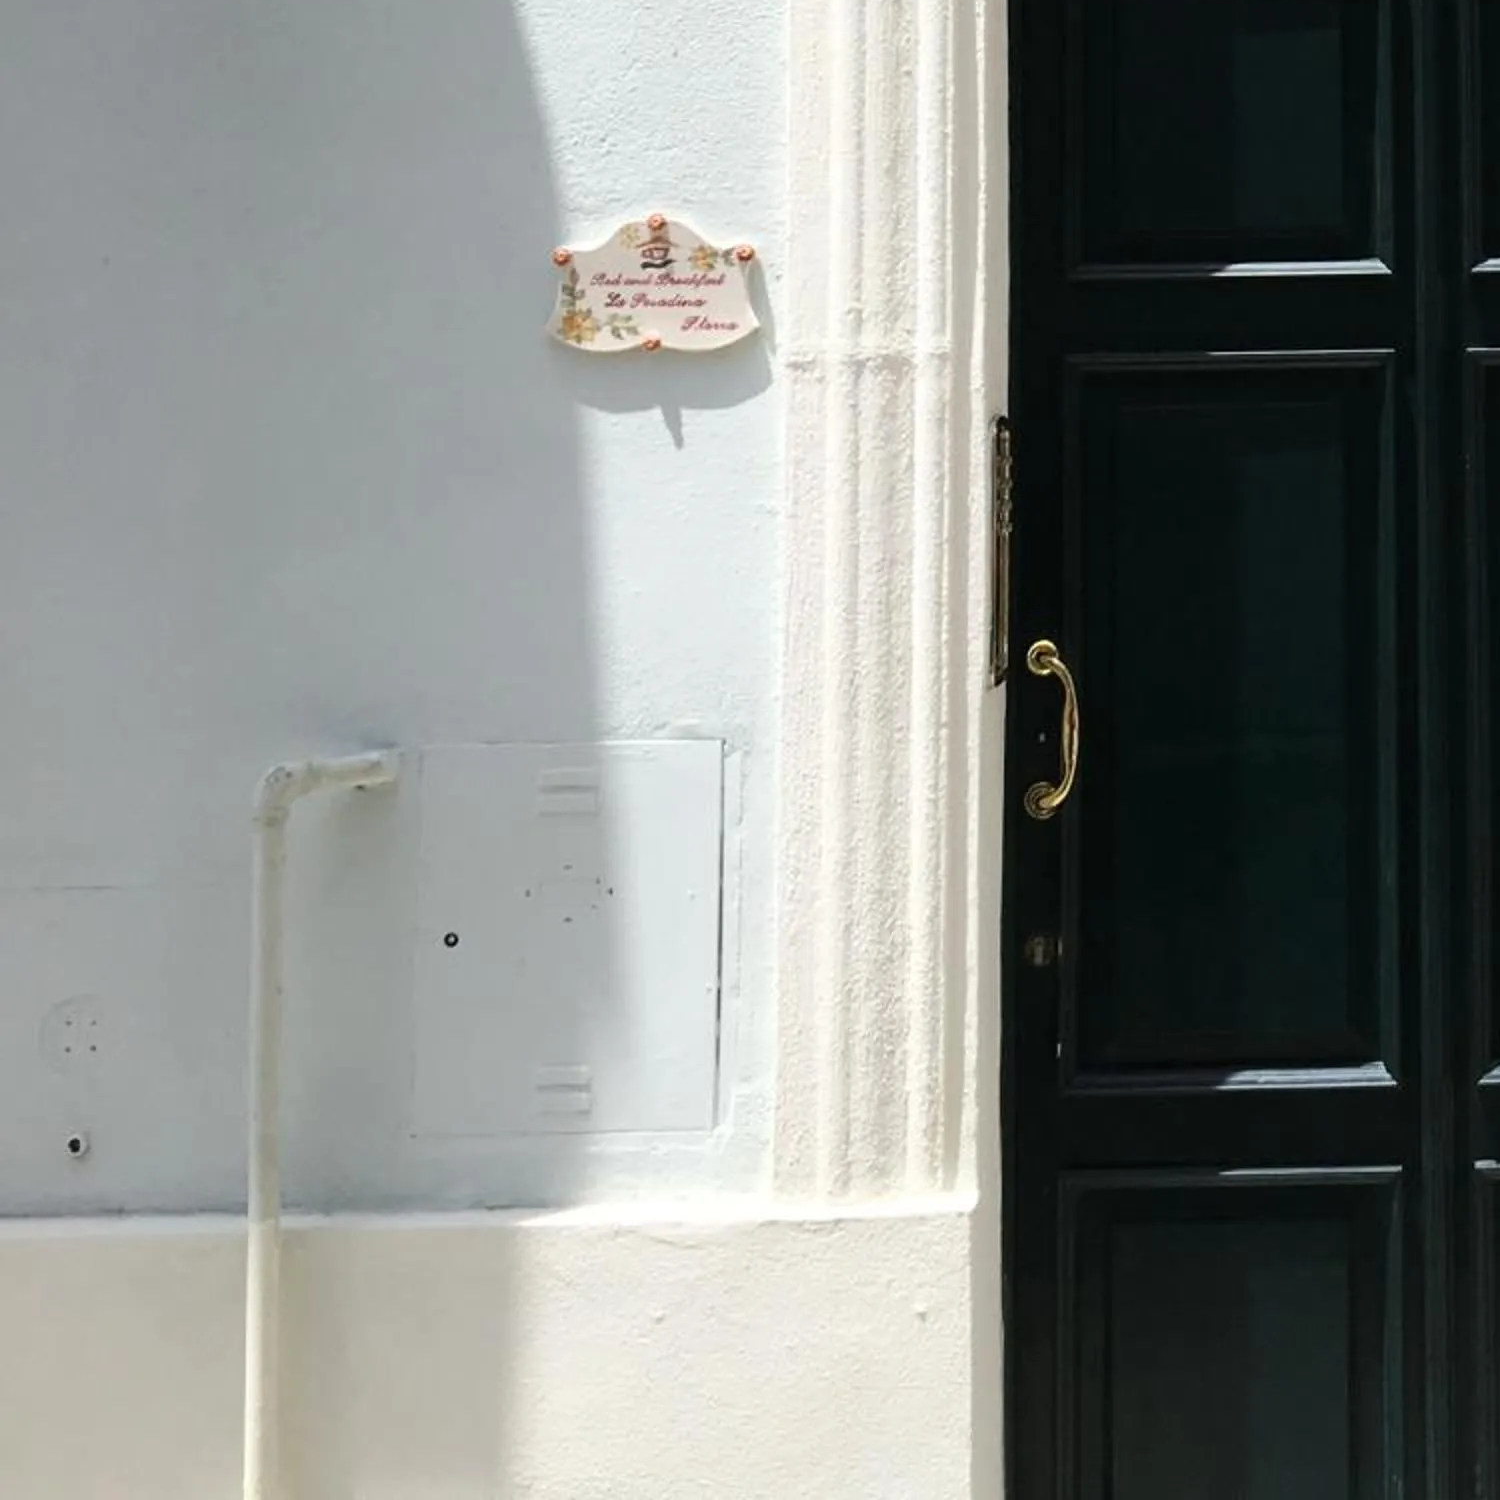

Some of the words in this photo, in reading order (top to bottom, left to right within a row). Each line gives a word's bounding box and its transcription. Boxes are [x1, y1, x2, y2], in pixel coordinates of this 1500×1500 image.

[590, 272, 622, 286] Bed
[624, 273, 653, 286] and
[655, 272, 726, 288] Breakfast
[604, 292, 626, 308] La
